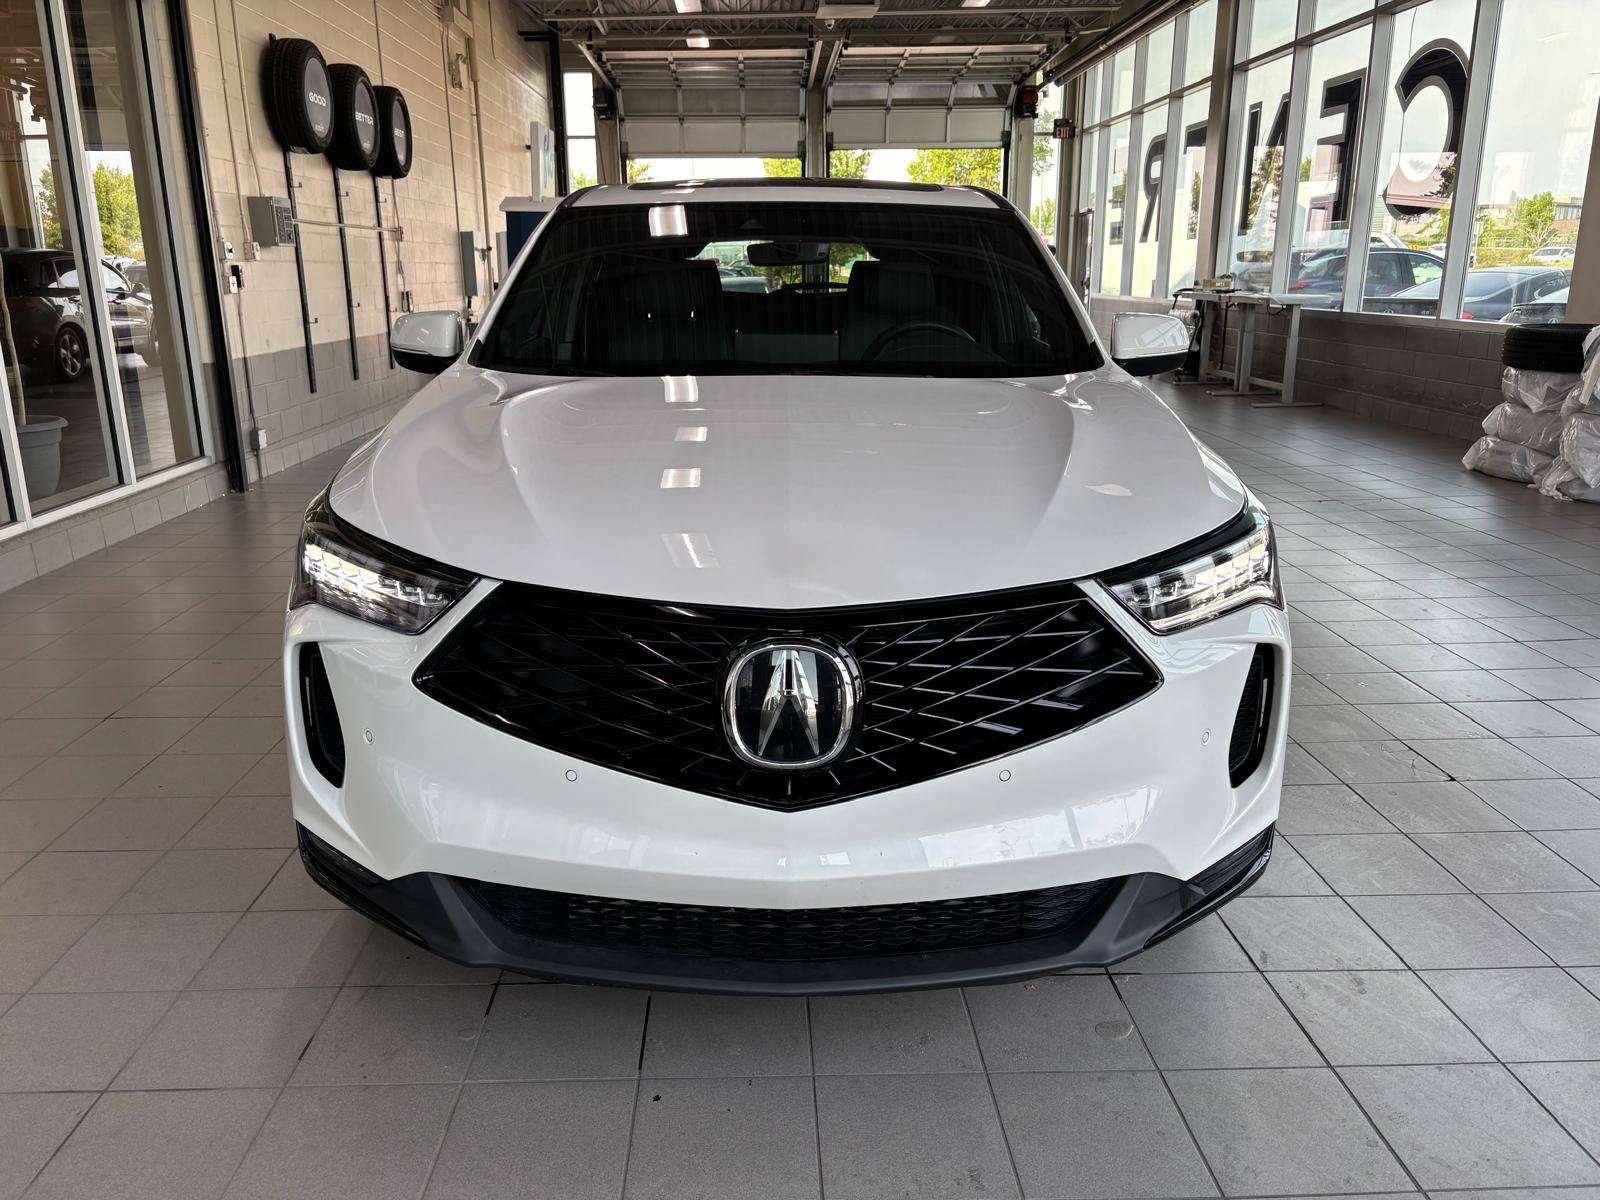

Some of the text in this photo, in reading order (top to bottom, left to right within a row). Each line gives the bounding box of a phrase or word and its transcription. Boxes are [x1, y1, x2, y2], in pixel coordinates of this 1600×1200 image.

[308, 91, 327, 107] GOOD
[355, 111, 374, 126] BETTER
[394, 127, 405, 138] BEST
[1056, 127, 1070, 138] EXIT
